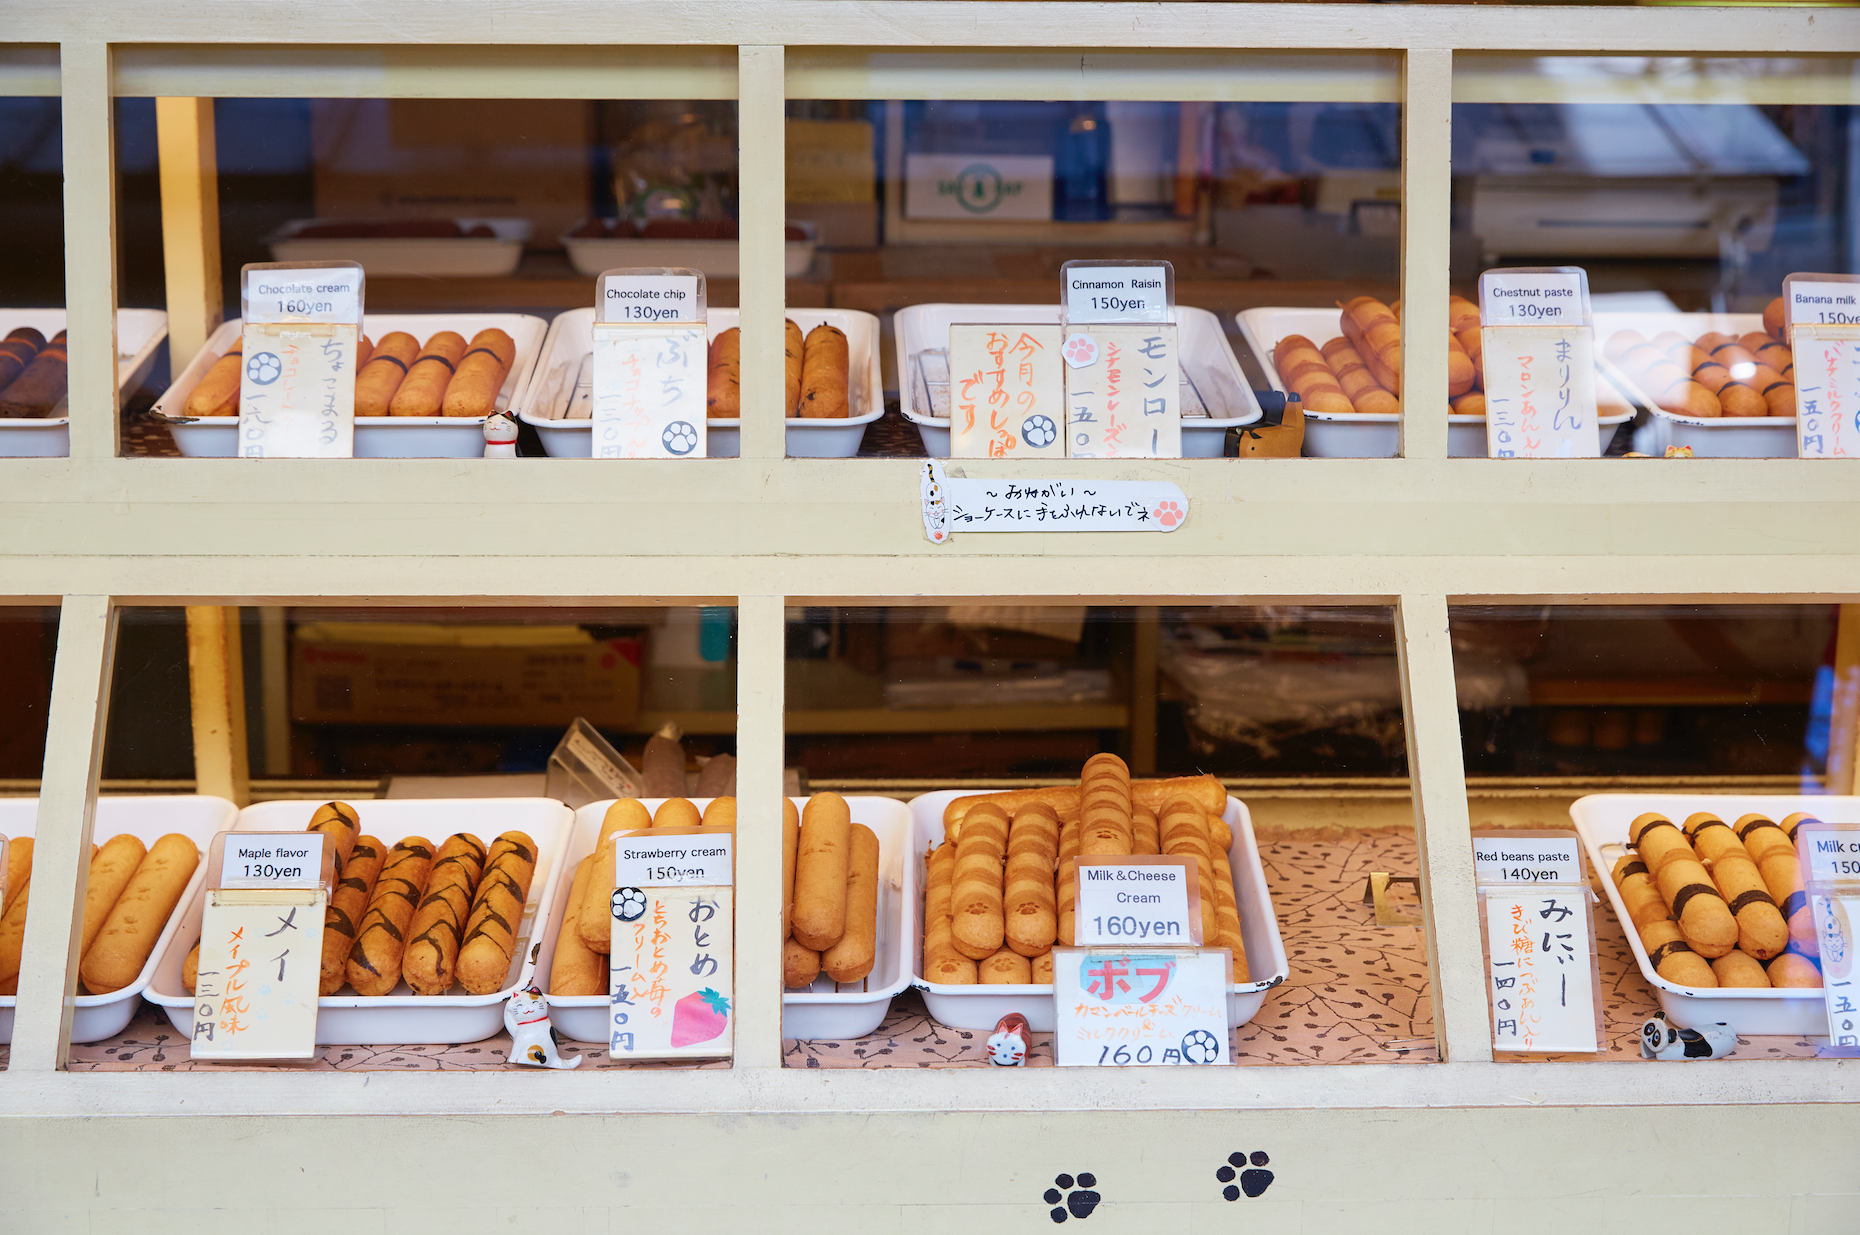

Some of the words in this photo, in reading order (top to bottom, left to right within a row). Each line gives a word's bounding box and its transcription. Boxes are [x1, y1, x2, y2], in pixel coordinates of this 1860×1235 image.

[258, 284, 313, 295] Chocolate
[316, 284, 350, 293] cream
[1072, 279, 1124, 290] Cinnamon
[1131, 279, 1162, 289] Raisin
[606, 289, 660, 299] Chocolate
[663, 289, 686, 301] chip
[1493, 287, 1541, 297] Chestnut
[1544, 288, 1573, 299] paste
[1795, 293, 1833, 304] Banana
[1836, 295, 1857, 305] milk
[277, 300, 332, 315] 160yen
[1091, 296, 1145, 312] 150yen
[1508, 304, 1562, 320] 130yen
[624, 306, 679, 321] 130yen
[656, 329, 698, 407] ぶち
[1008, 332, 1045, 417] 今月の
[1553, 337, 1583, 431] まりりん
[958, 369, 984, 436] です
[1103, 341, 1127, 458] シナモンレーズン
[1137, 336, 1167, 456] モンロー
[238, 848, 272, 860] Maple
[275, 848, 309, 858] flavor
[623, 848, 687, 860] Strawberry
[691, 847, 727, 857] cream
[1816, 840, 1846, 853] Milk
[1476, 851, 1498, 862] Red
[1501, 851, 1535, 862] beans
[1538, 852, 1570, 863] paste
[243, 864, 302, 880] 130yen
[646, 866, 705, 882] 150yen
[1500, 867, 1559, 883] 140yen
[1116, 892, 1161, 904] Cream
[1093, 916, 1180, 938] 160yen
[264, 906, 298, 982] メイ
[688, 895, 721, 978] おとめ
[219, 926, 251, 1036] メイプル風味
[1086, 956, 1177, 1004] ボブ
